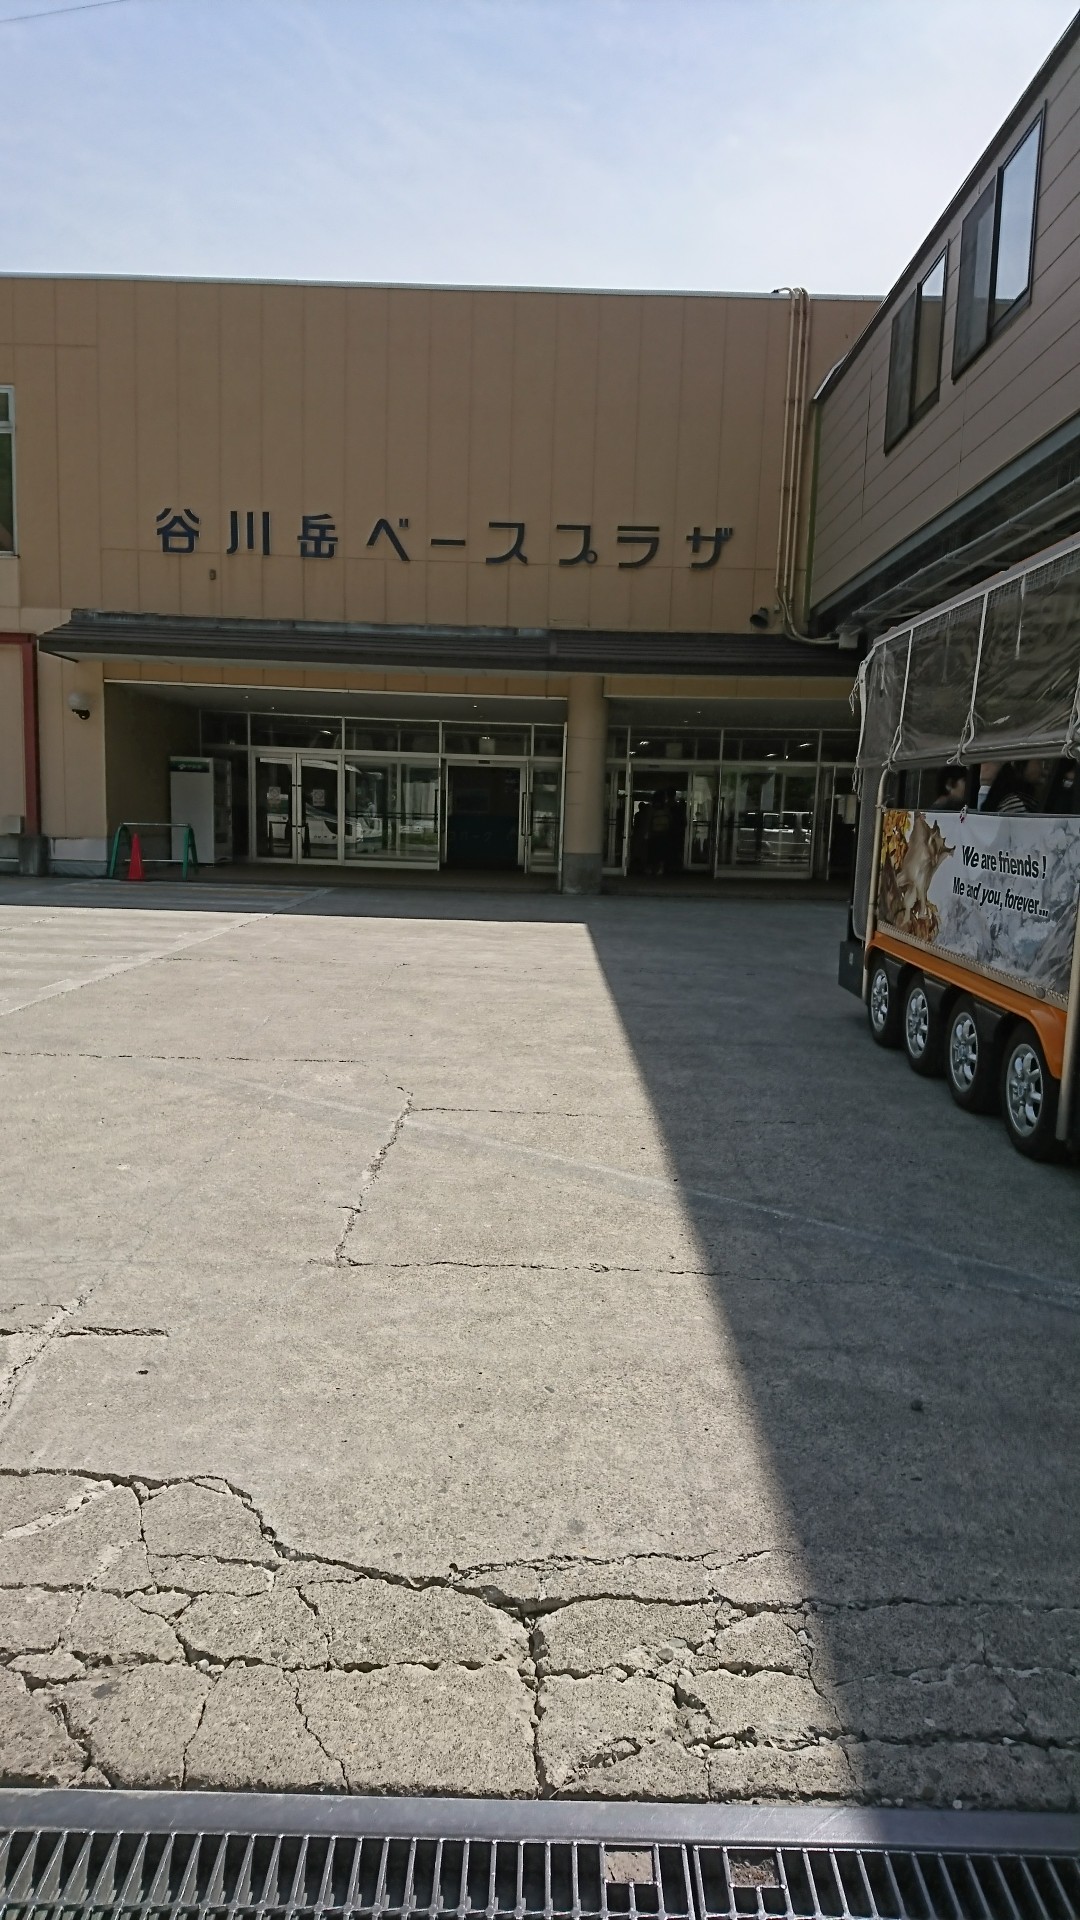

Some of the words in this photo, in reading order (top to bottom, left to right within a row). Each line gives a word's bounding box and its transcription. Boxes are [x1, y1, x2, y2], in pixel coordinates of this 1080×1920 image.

[156, 508, 733, 569] 谷川岳ベースプラザ
[962, 845, 979, 868] We
[981, 853, 997, 871] are
[953, 876, 965, 896] Me
[980, 888, 1002, 911] you,
